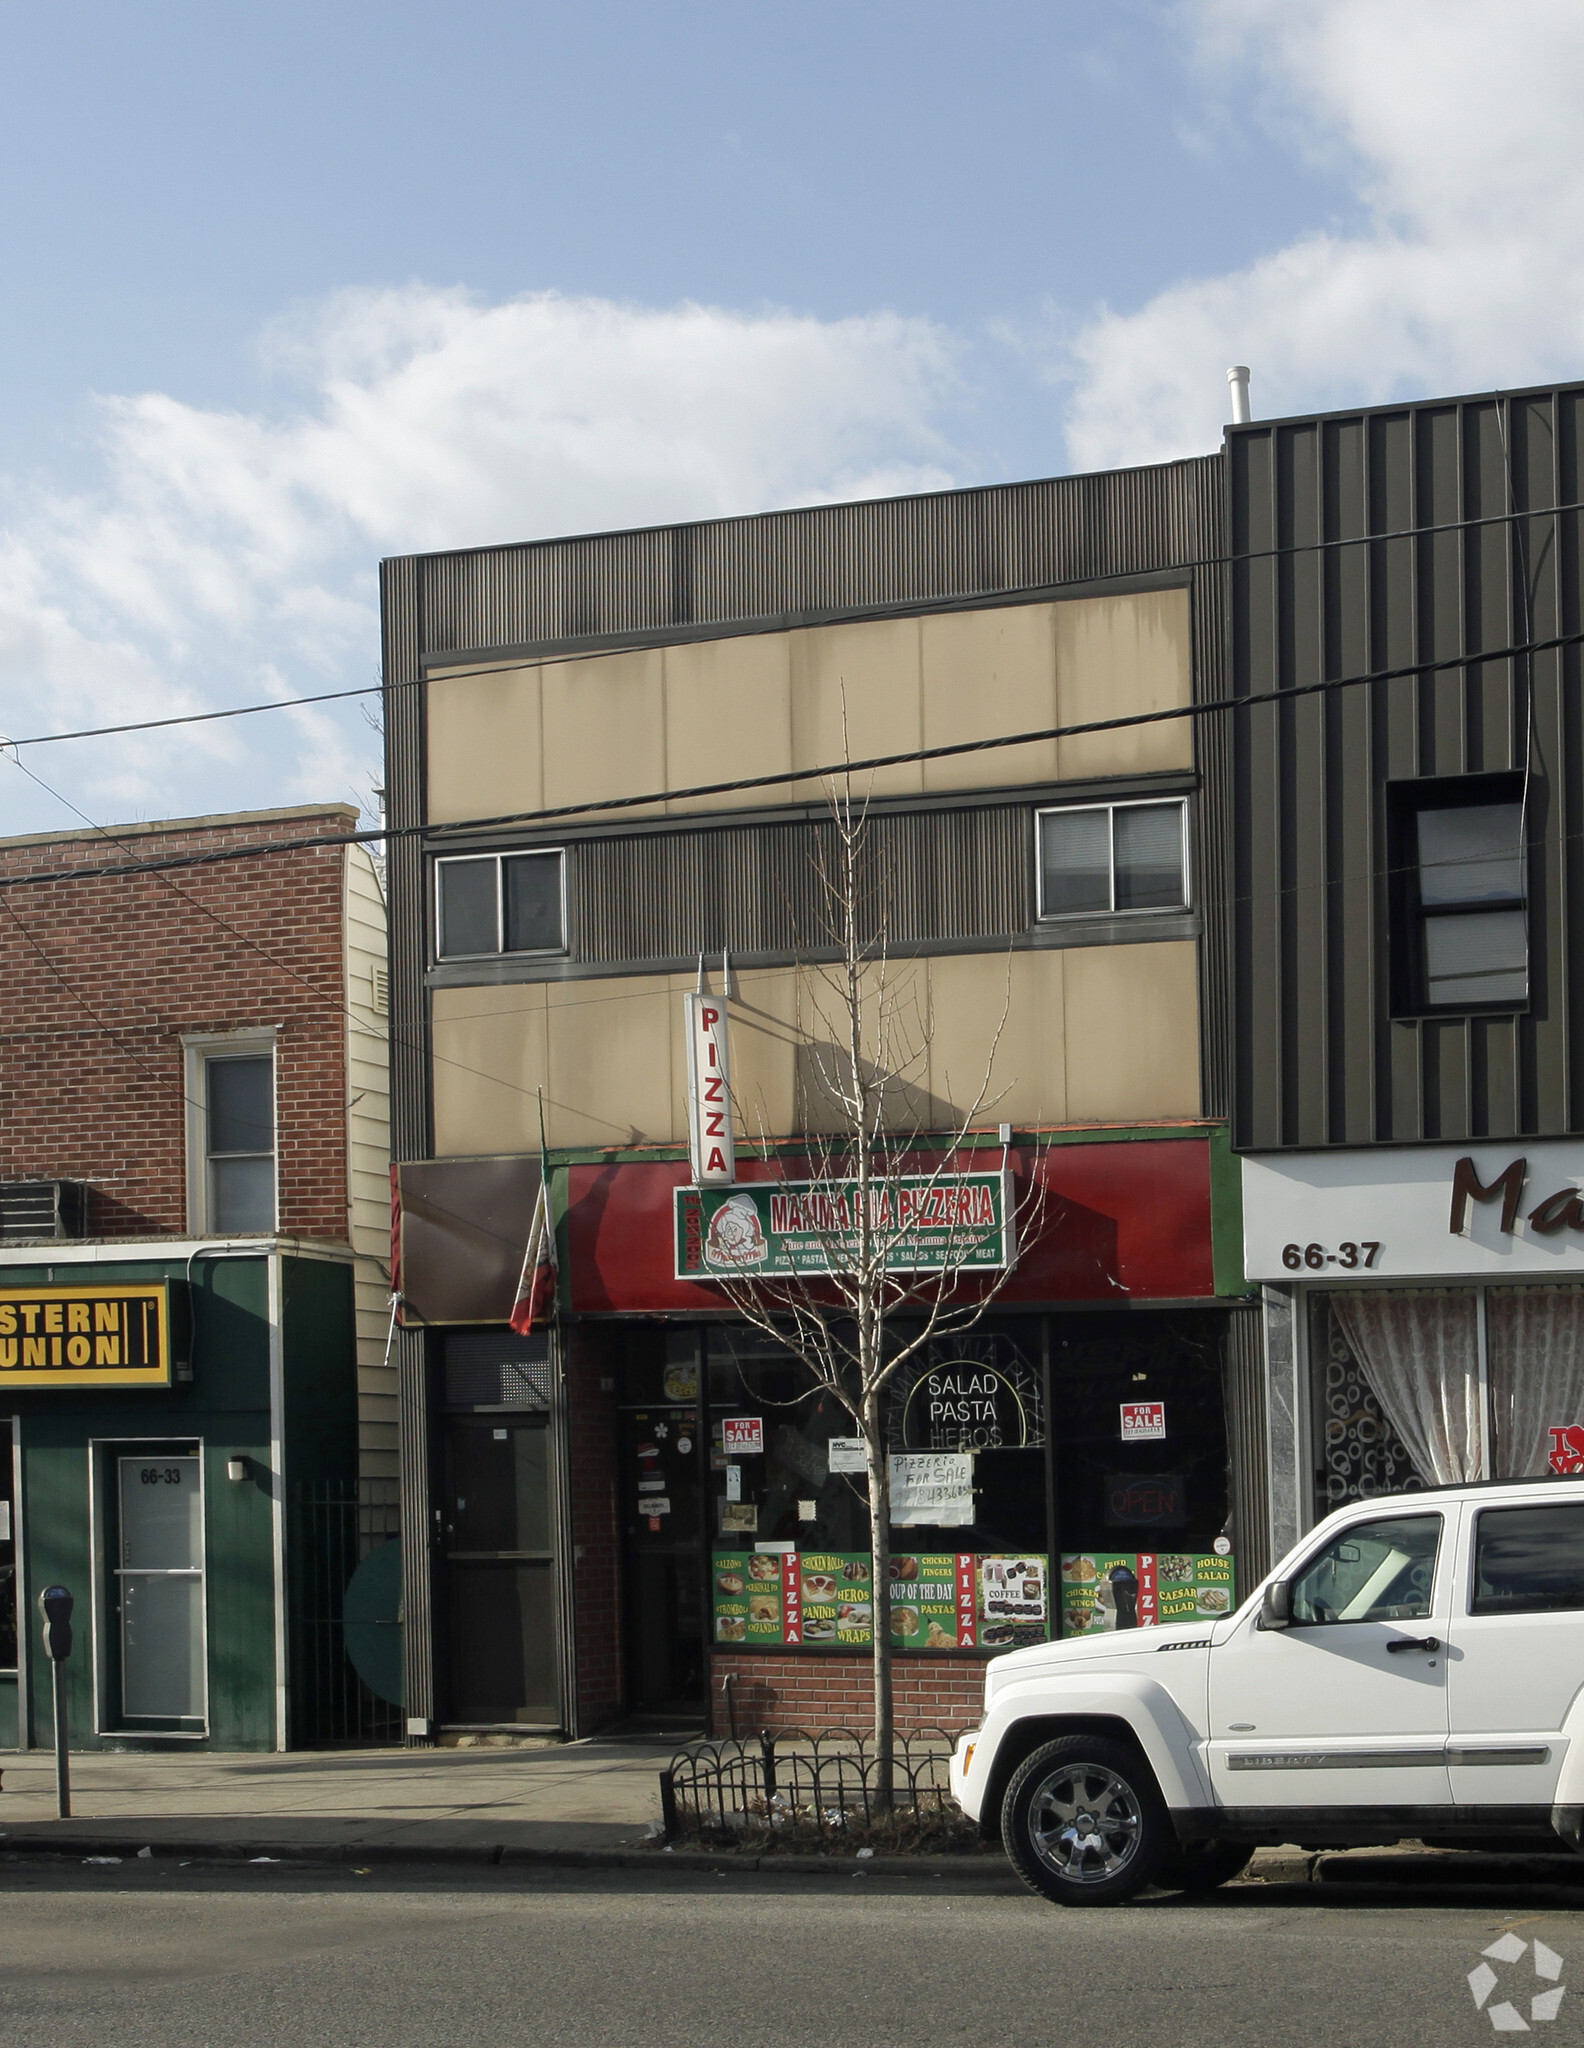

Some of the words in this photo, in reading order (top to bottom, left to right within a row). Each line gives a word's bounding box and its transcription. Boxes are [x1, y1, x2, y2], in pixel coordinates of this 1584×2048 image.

[702, 1008, 727, 1172] PIZZA
[770, 1192, 851, 1234] MAMMA
[898, 1185, 995, 1228] PIZZERIA
[1282, 1242, 1380, 1269] 66-37
[0, 1303, 119, 1334] STERN
[0, 1335, 120, 1367] UNION
[928, 1373, 998, 1395] SALAD
[930, 1401, 998, 1422] PASTA
[1134, 1407, 1151, 1415] FOR
[735, 1422, 750, 1430] FOR
[1125, 1414, 1162, 1427] SALE
[726, 1429, 760, 1441] SALE
[930, 1427, 1003, 1448] HEROS
[141, 1469, 181, 1484] 66-33
[904, 1473, 930, 1488] FOR
[934, 1466, 966, 1484] SALE
[1111, 1489, 1176, 1513] OPEN
[922, 1556, 953, 1565] CHICKEN
[1197, 1558, 1230, 1569] HOUSE
[922, 1568, 953, 1576] FINGERS
[1197, 1571, 1230, 1580] SALAD
[786, 1554, 799, 1642] PIZZA
[837, 1588, 870, 1602] HEROS
[889, 1583, 905, 1600] OUP
[907, 1583, 918, 1600] OF
[919, 1583, 935, 1600] THE
[937, 1583, 954, 1600] DAY
[989, 1590, 1021, 1598] COFFEE
[1066, 1588, 1099, 1598] CHICKEN
[1141, 1556, 1154, 1627] PIZZ
[1159, 1588, 1197, 1601] CAESAR
[960, 1555, 974, 1646] PIZZA
[1070, 1599, 1095, 1607] WINGS
[802, 1605, 837, 1619] PANINIS
[921, 1605, 956, 1614] PASTAS
[1162, 1602, 1195, 1615] SALAD
[837, 1629, 871, 1643] WRAPS
[1243, 1755, 1327, 1766] LIBERTY
